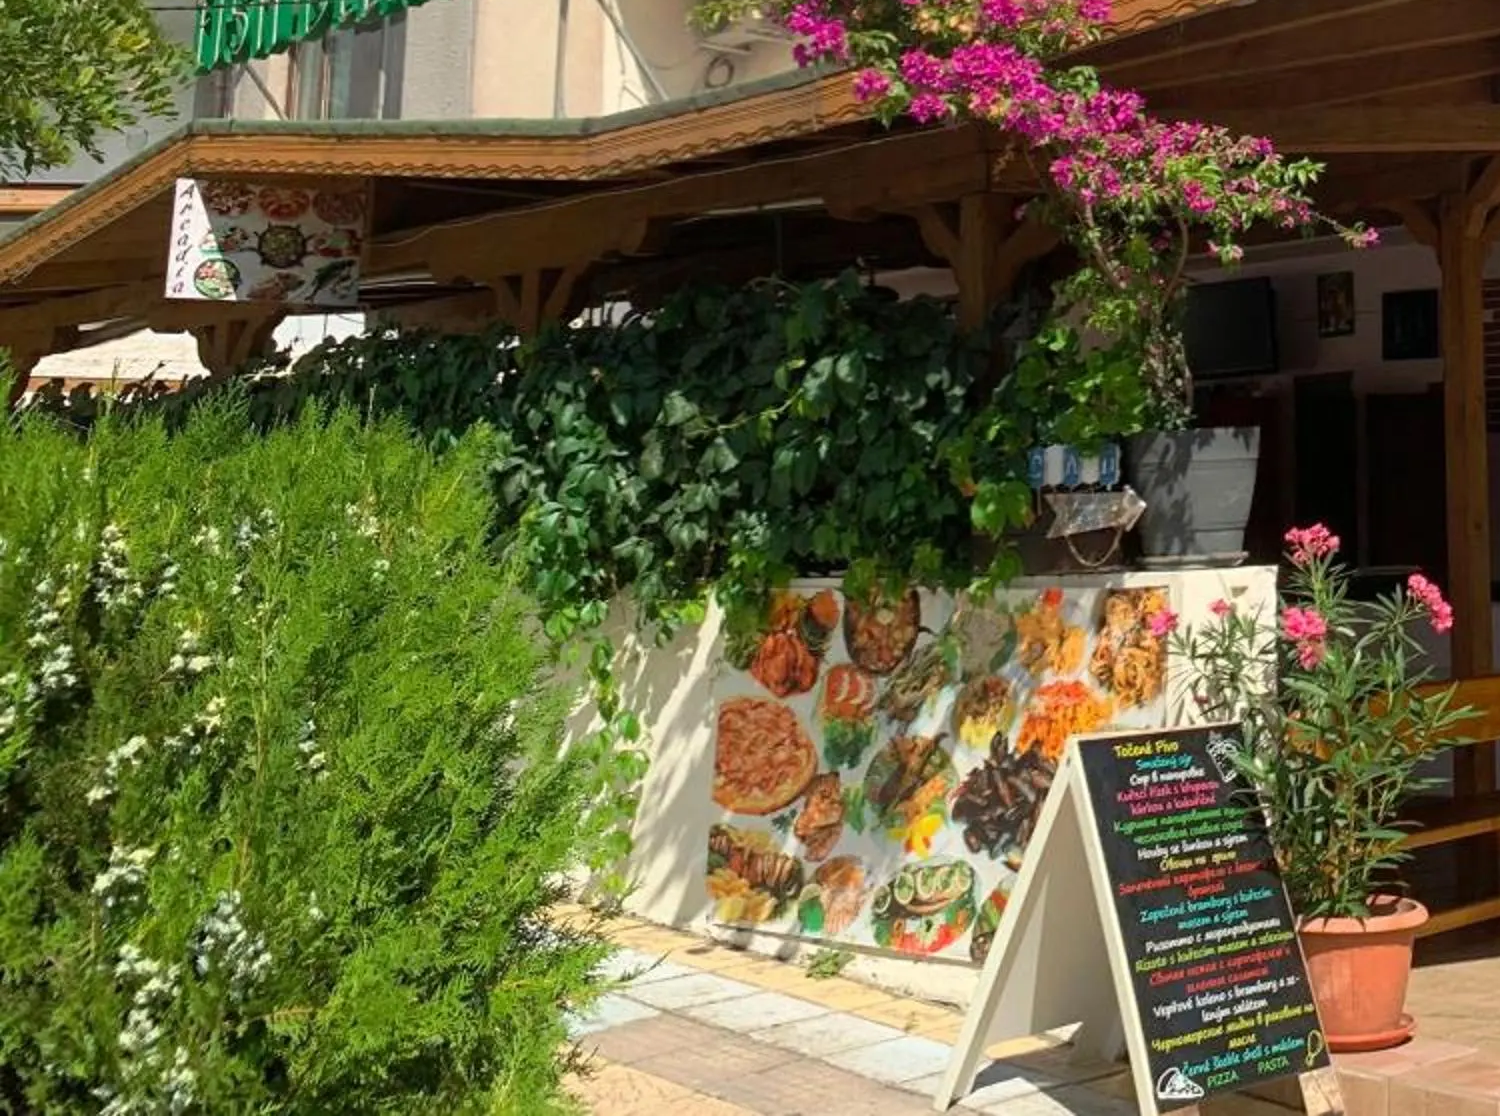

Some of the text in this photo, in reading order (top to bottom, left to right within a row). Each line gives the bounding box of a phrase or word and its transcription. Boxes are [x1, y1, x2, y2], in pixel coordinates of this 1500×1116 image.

[171, 182, 196, 295] Arcadia
[1206, 1055, 1290, 1087] PIZZA PASTA
